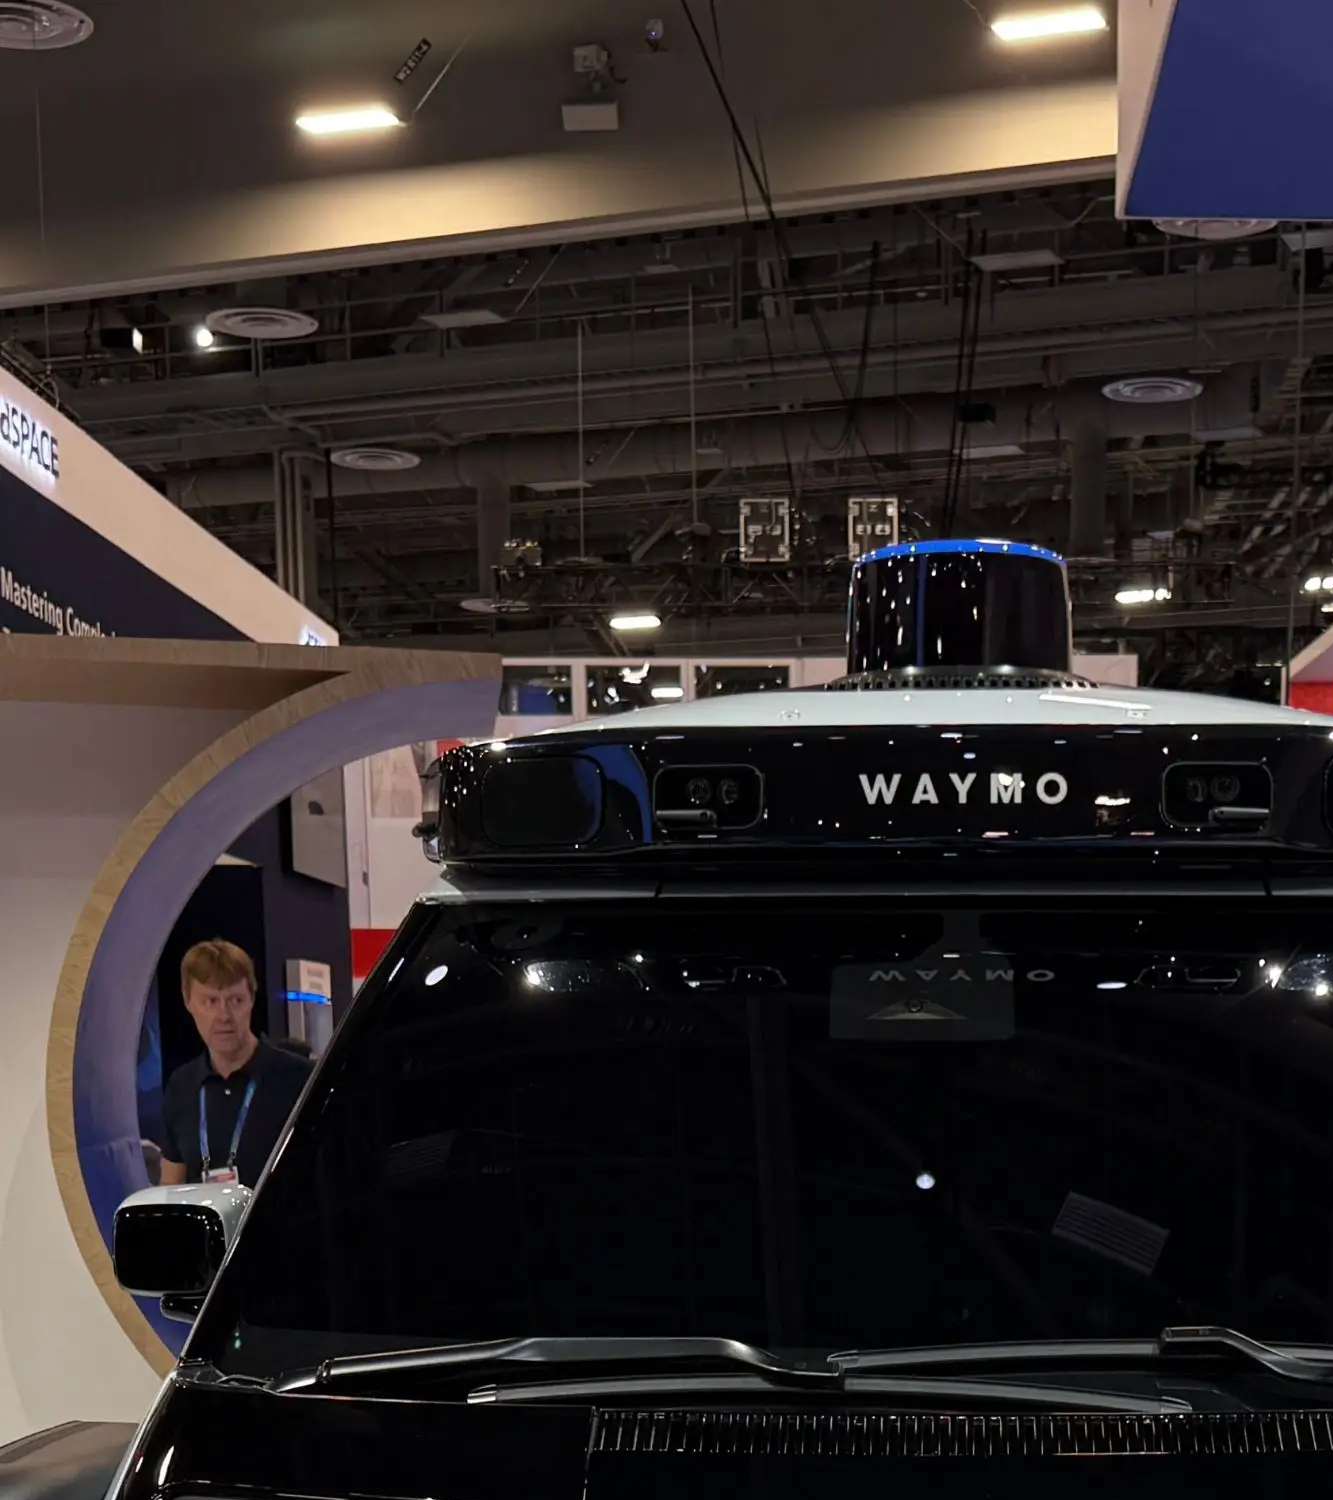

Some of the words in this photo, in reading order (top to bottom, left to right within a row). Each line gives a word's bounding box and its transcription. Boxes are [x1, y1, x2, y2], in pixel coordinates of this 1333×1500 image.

[0, 402, 60, 479] dSPACE
[0, 566, 64, 636] Mastering
[858, 771, 1069, 806] WAYMO
